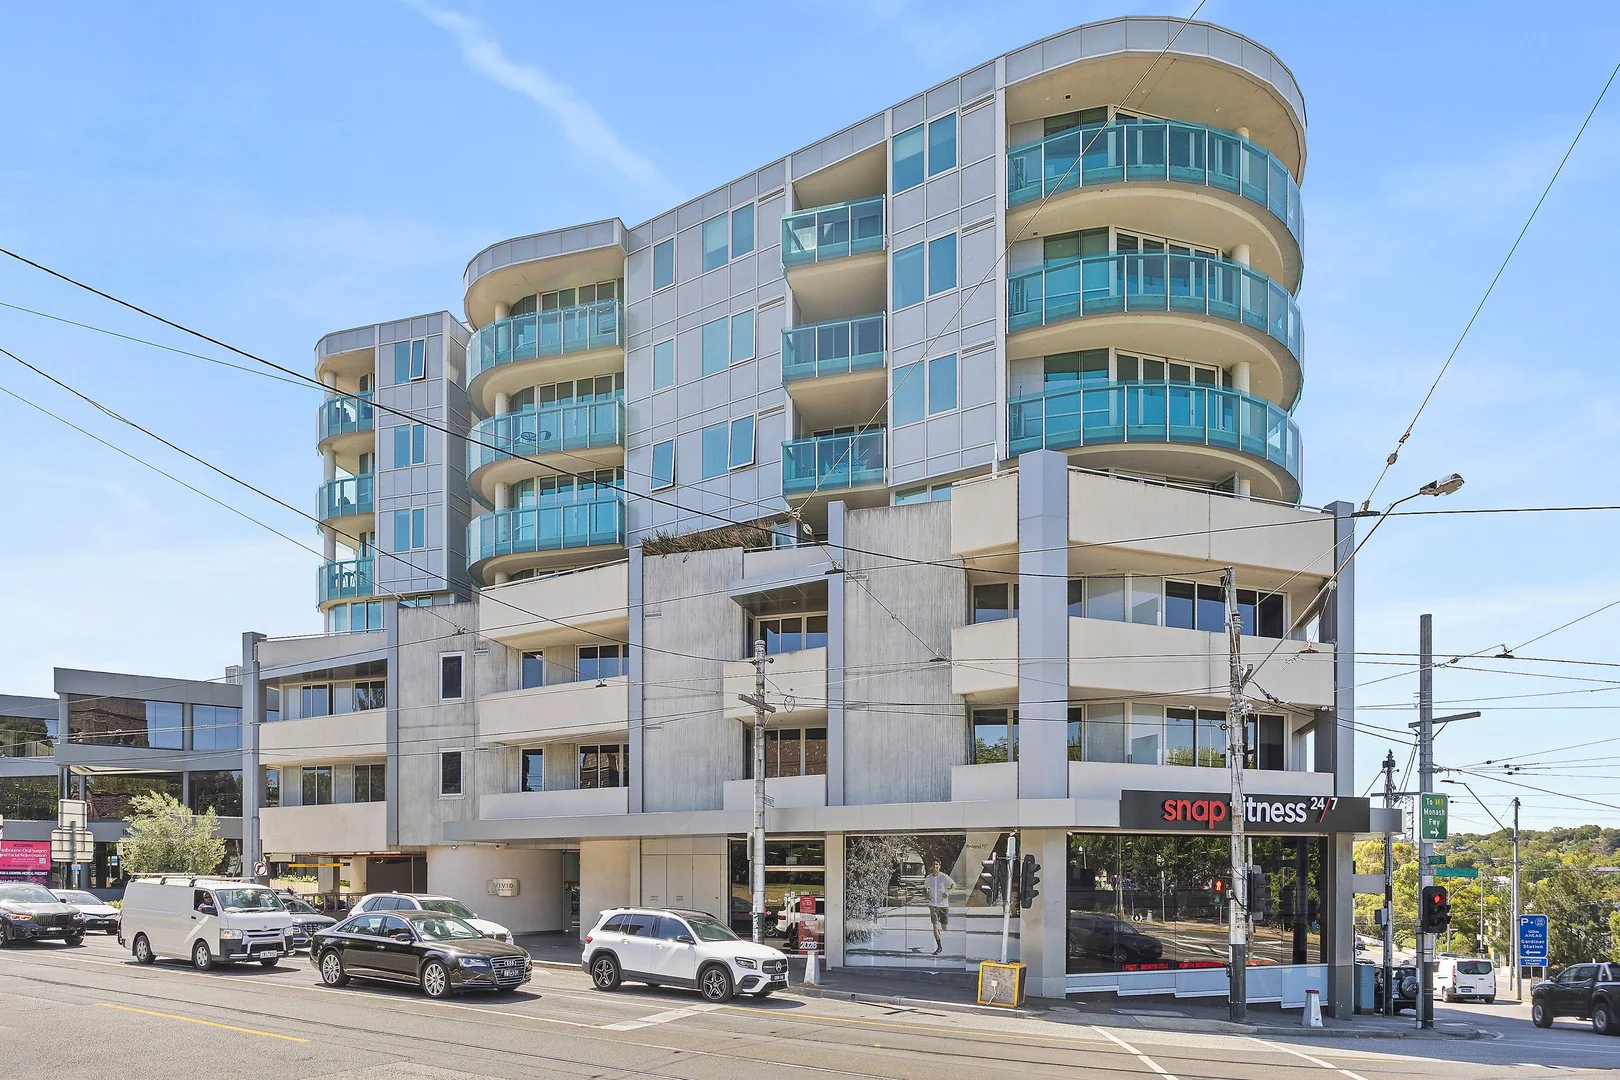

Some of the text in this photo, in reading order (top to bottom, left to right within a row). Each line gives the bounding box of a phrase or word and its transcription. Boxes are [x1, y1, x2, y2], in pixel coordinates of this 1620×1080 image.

[1426, 798, 1433, 806] To
[1163, 795, 1338, 829] snap itness 24/7
[1423, 808, 1446, 816] Monash
[1428, 819, 1441, 827] Fwy
[1520, 917, 1529, 926] P
